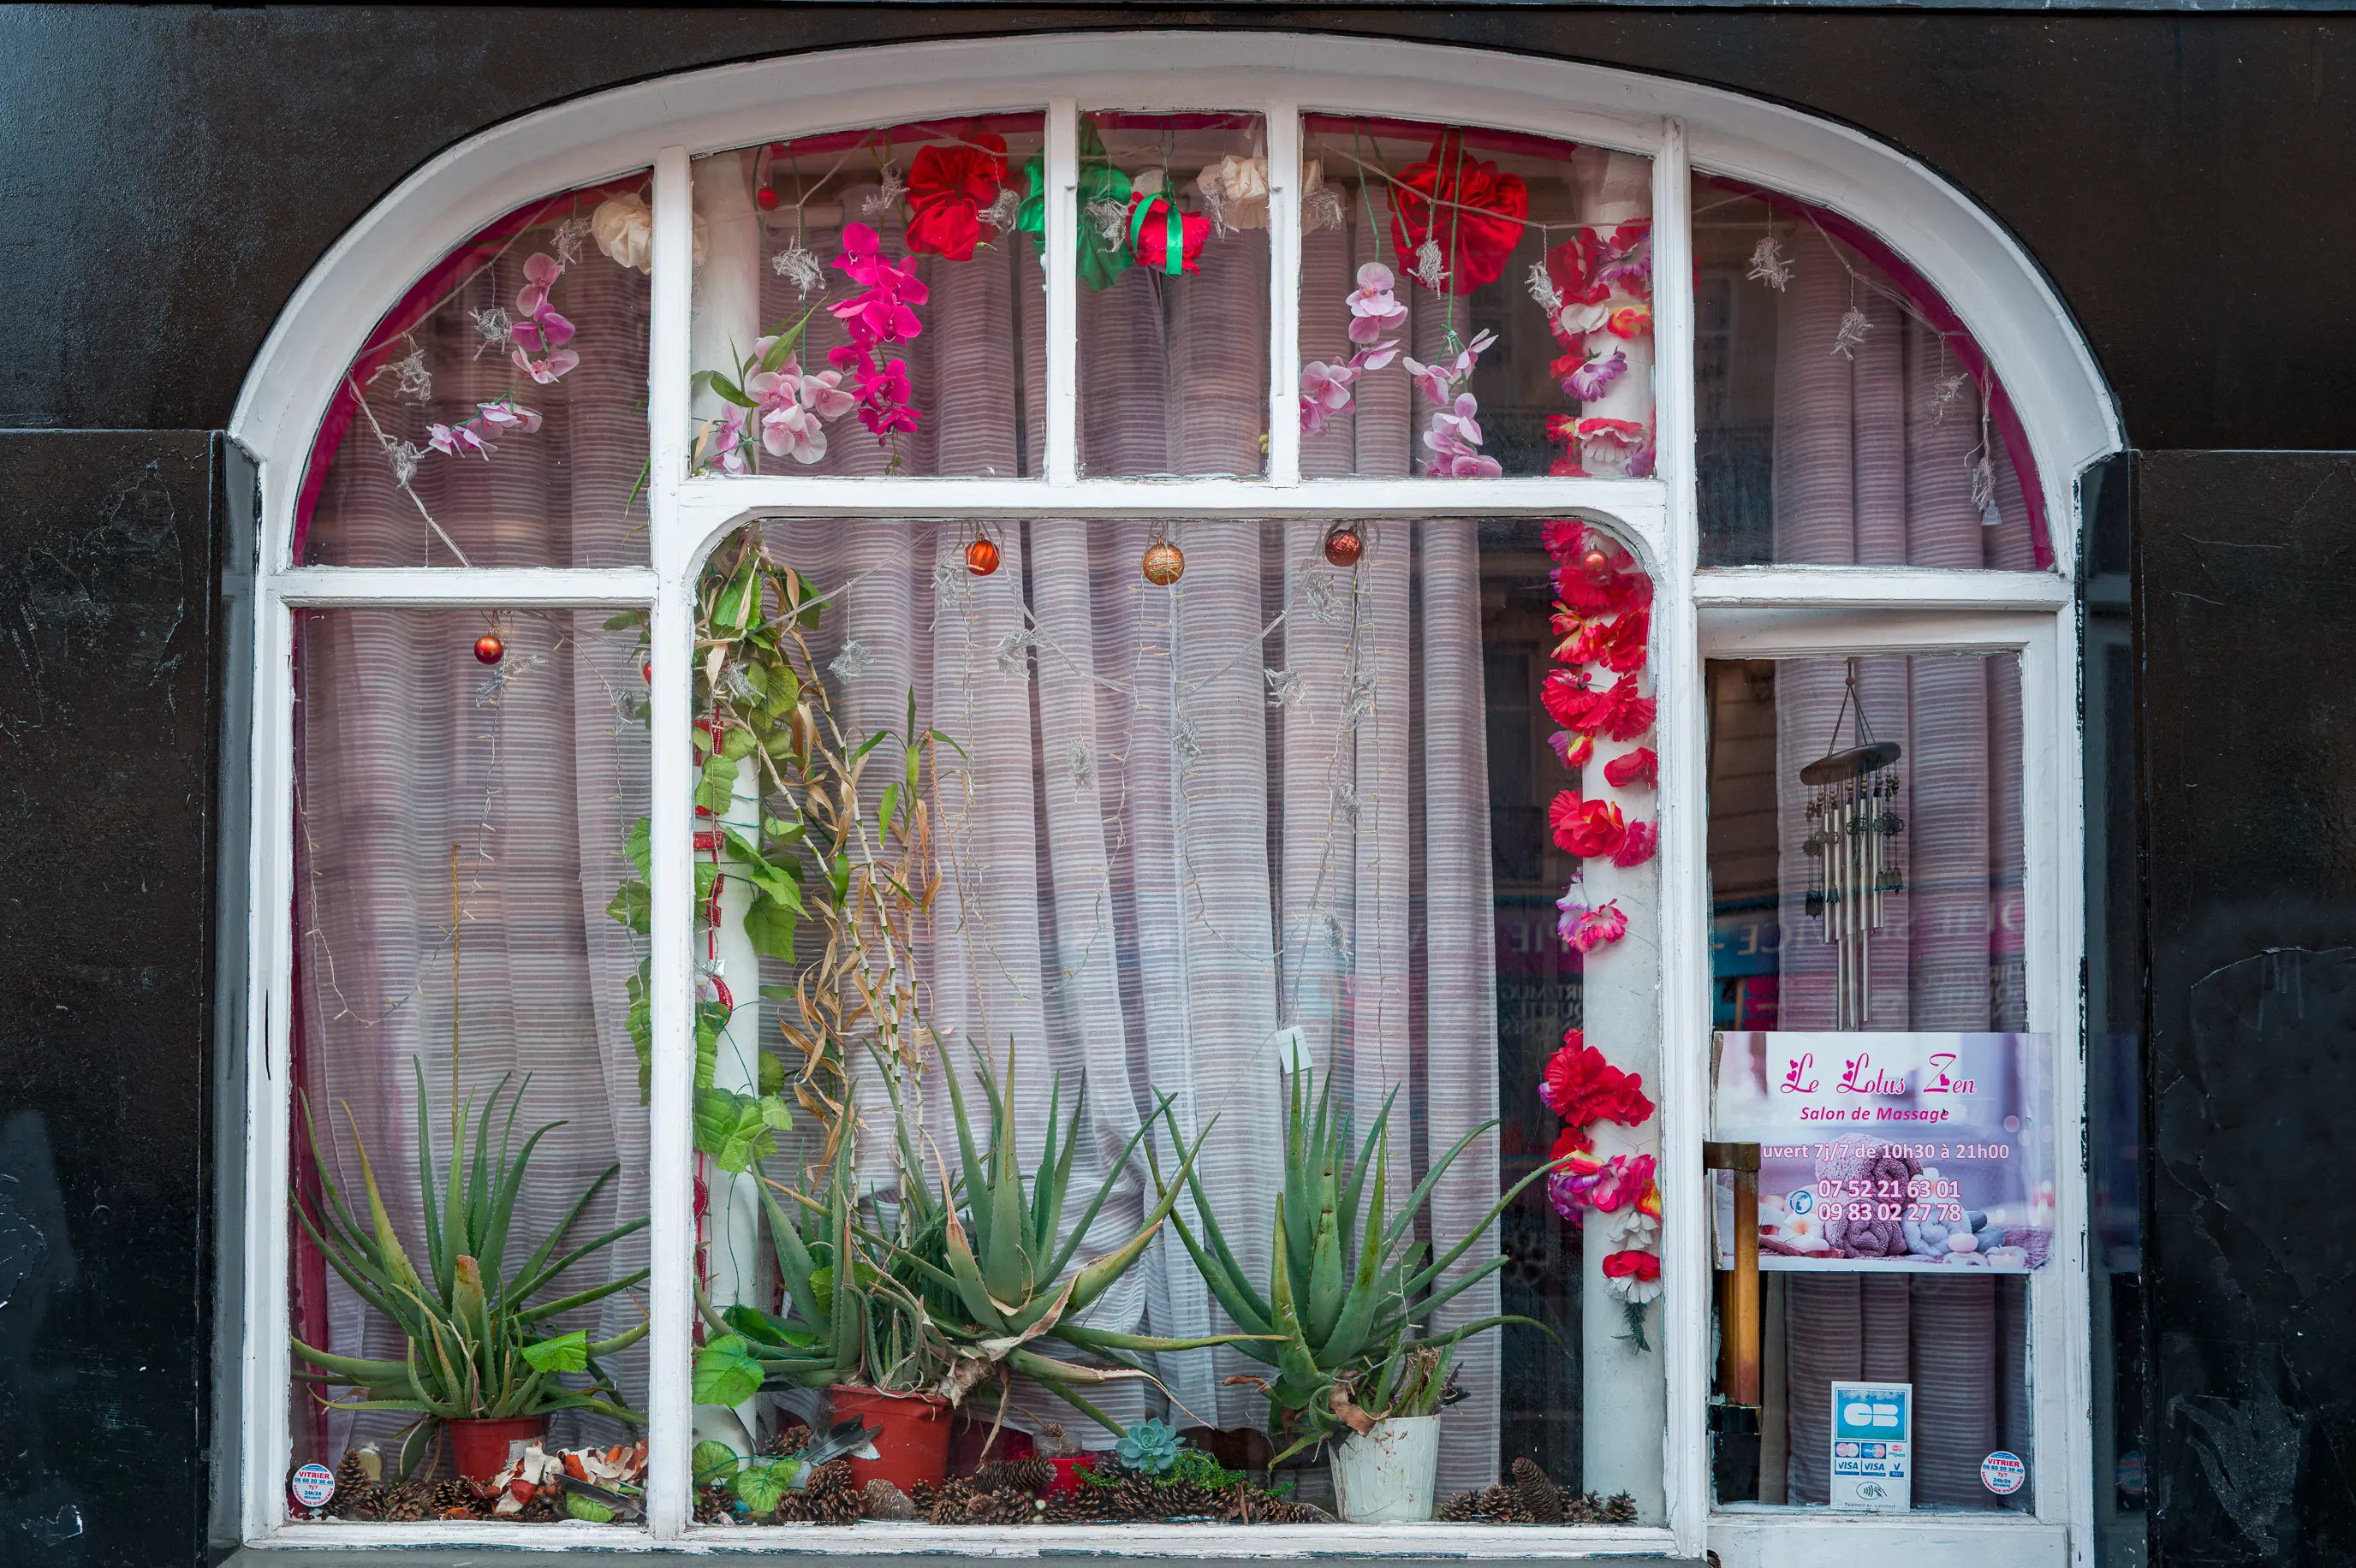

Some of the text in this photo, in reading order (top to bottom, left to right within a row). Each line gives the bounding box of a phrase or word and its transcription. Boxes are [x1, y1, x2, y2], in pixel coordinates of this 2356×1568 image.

[1780, 1052, 1977, 1095] Le Lotus Zen
[1800, 1106, 1949, 1123] Salon de Massage
[1761, 1142, 2010, 1161] uvert 7j/7 de 10h30 à 21h00
[1818, 1179, 1961, 1198] 07 52 21 63 01
[1818, 1203, 1961, 1222] 09 83 02 27 78
[1987, 1458, 2020, 1467] VITRIER
